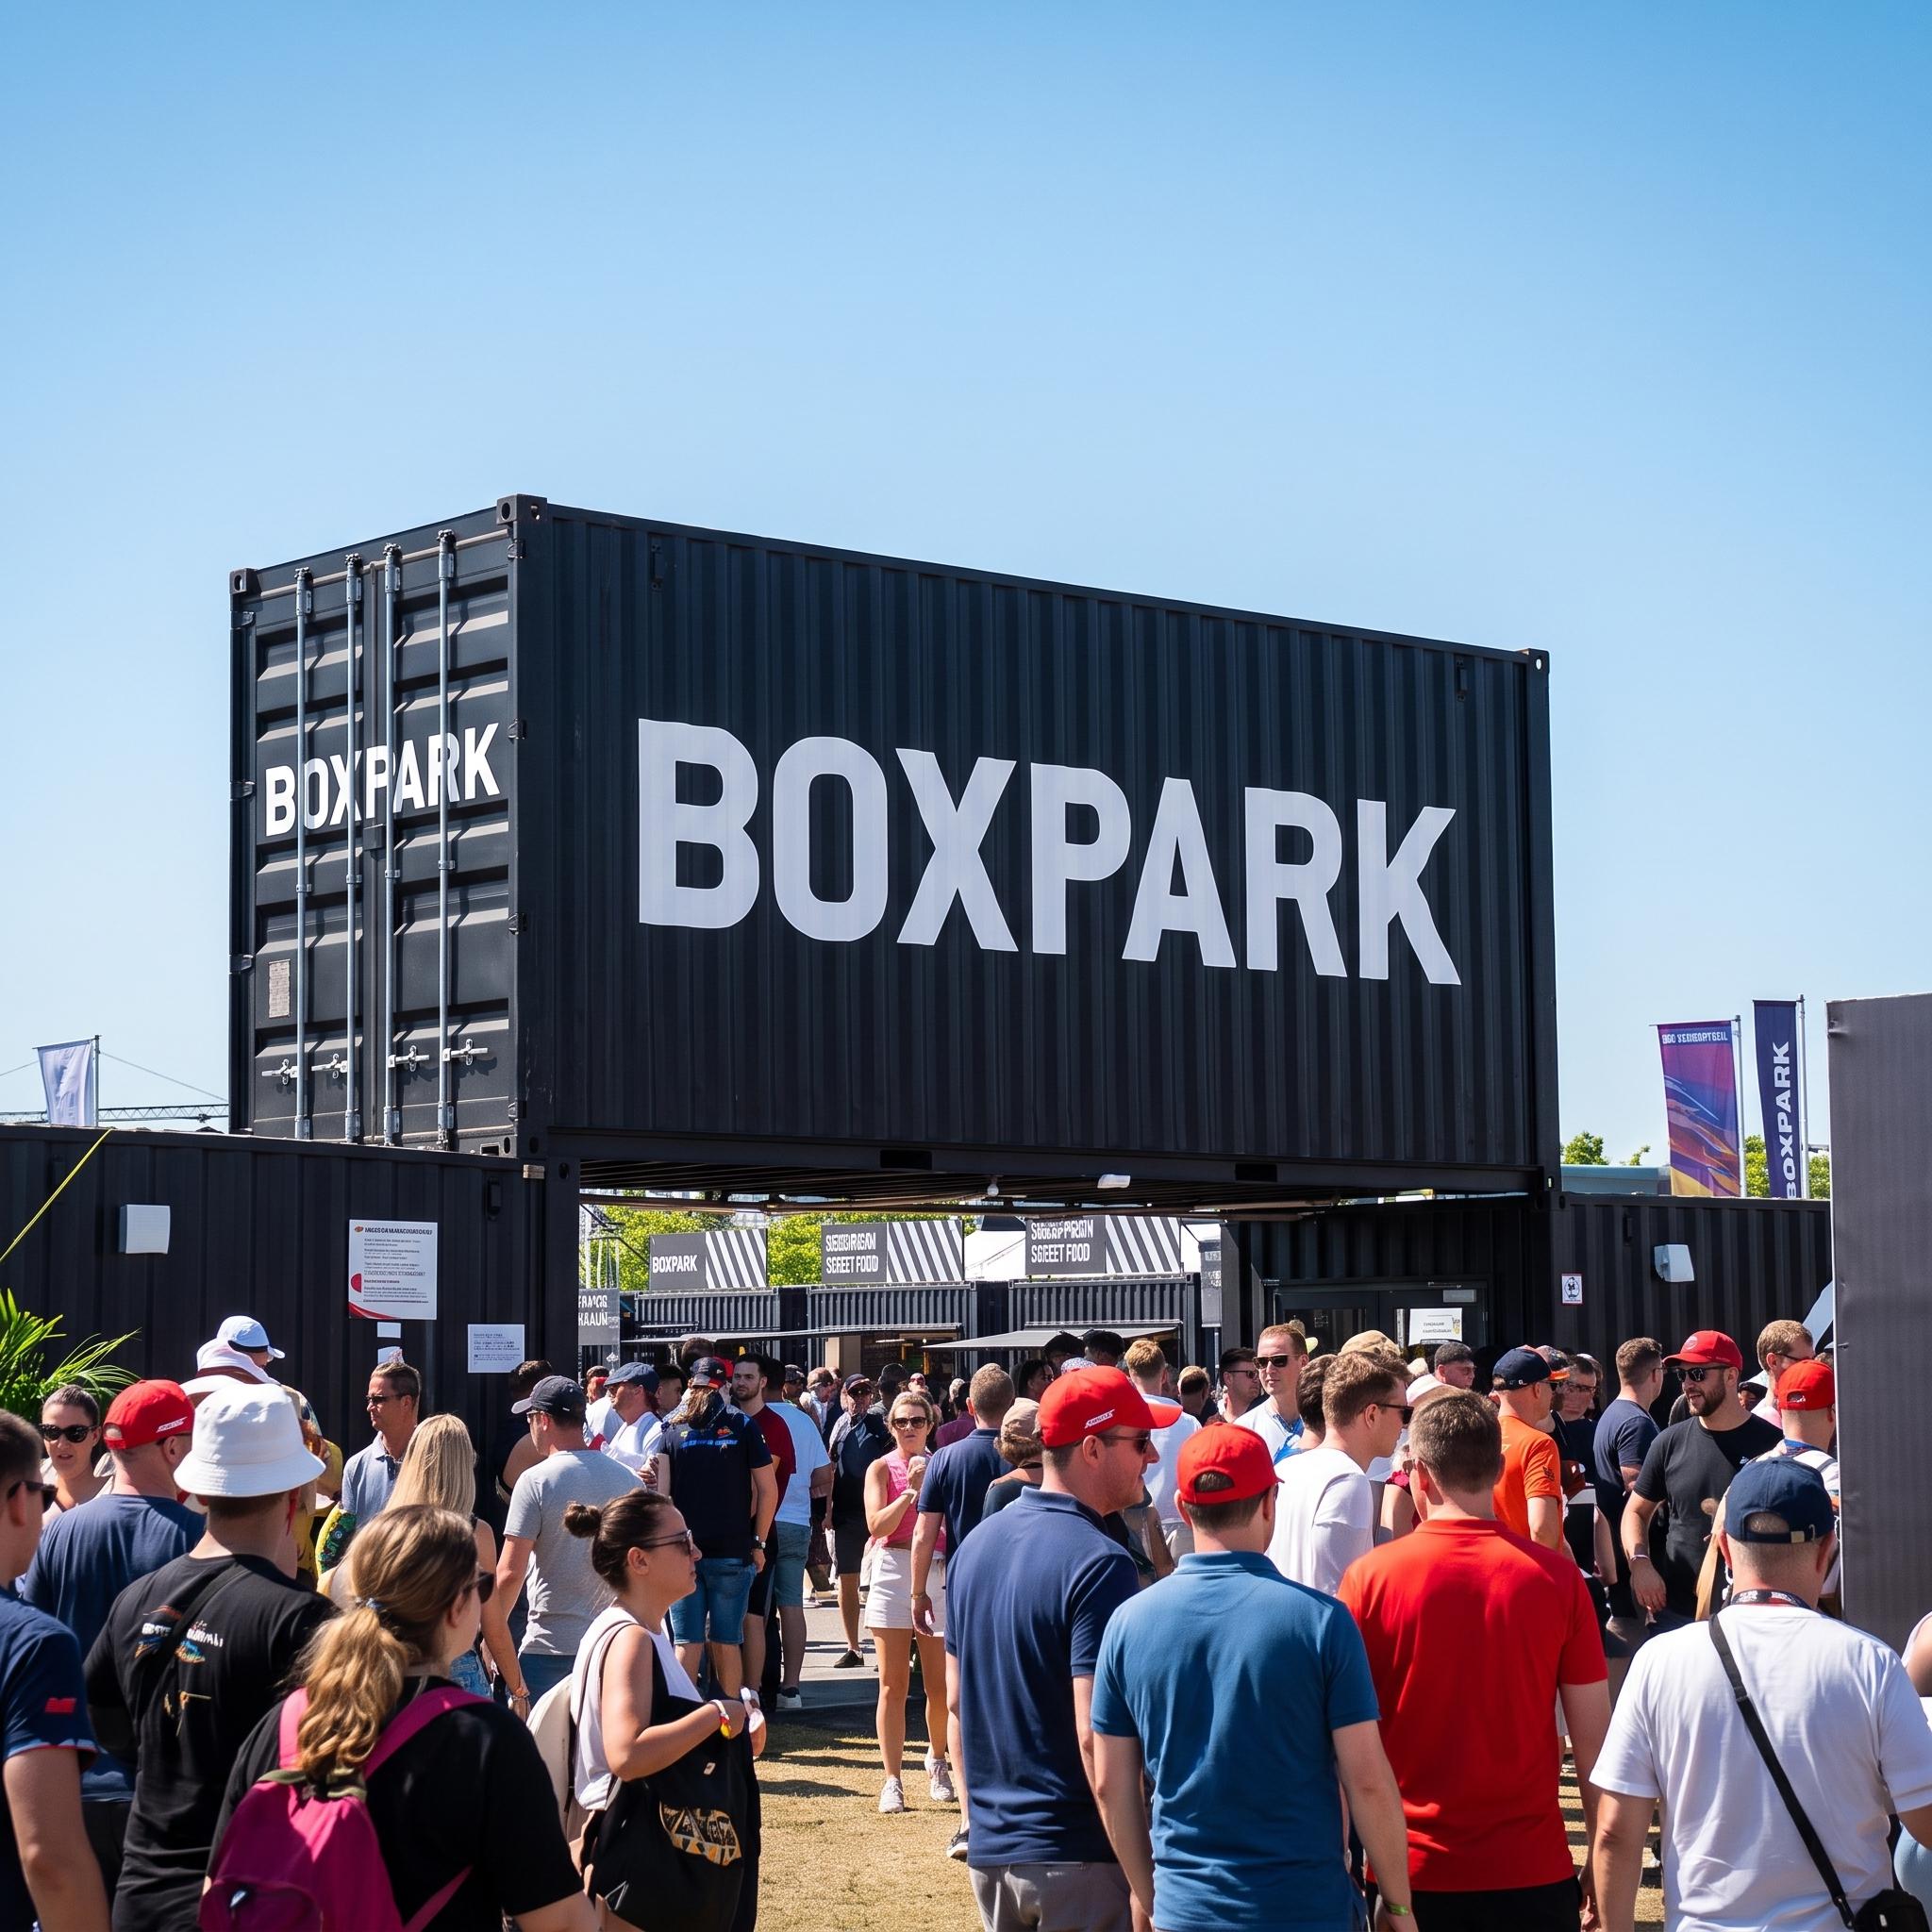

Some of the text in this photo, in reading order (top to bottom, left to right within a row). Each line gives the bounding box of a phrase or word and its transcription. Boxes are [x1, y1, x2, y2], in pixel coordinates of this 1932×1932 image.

[265, 723, 501, 837] BOXPARK
[639, 718, 1461, 985] BOXPARK
[1773, 1041, 1797, 1199] BOXPARK
[652, 1255, 697, 1274] BOXPARK
[1066, 1242, 1091, 1262] FOOD
